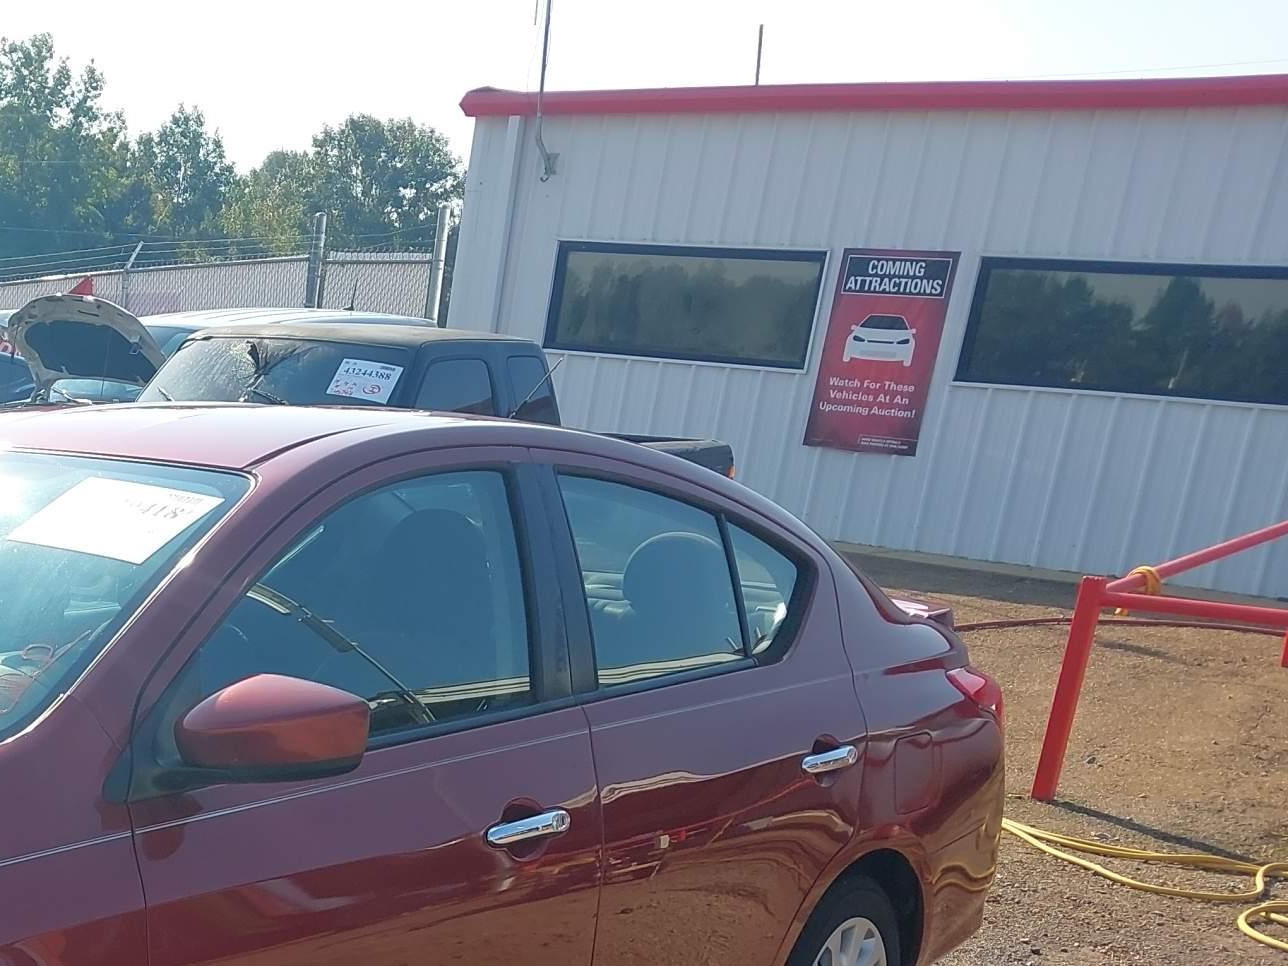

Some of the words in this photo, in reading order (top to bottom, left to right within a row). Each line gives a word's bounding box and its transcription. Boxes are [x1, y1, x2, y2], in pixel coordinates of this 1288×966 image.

[868, 260, 926, 276] COMING
[845, 276, 943, 294] ATTRACTIONS
[343, 367, 392, 381] 43244388
[829, 376, 860, 388] Watch
[863, 379, 881, 390] For
[884, 381, 915, 392] These
[829, 389, 874, 402] Vehicles
[876, 393, 890, 403] At
[893, 395, 909, 405] An
[819, 401, 869, 415] Upcoming
[870, 406, 916, 418] Auction!
